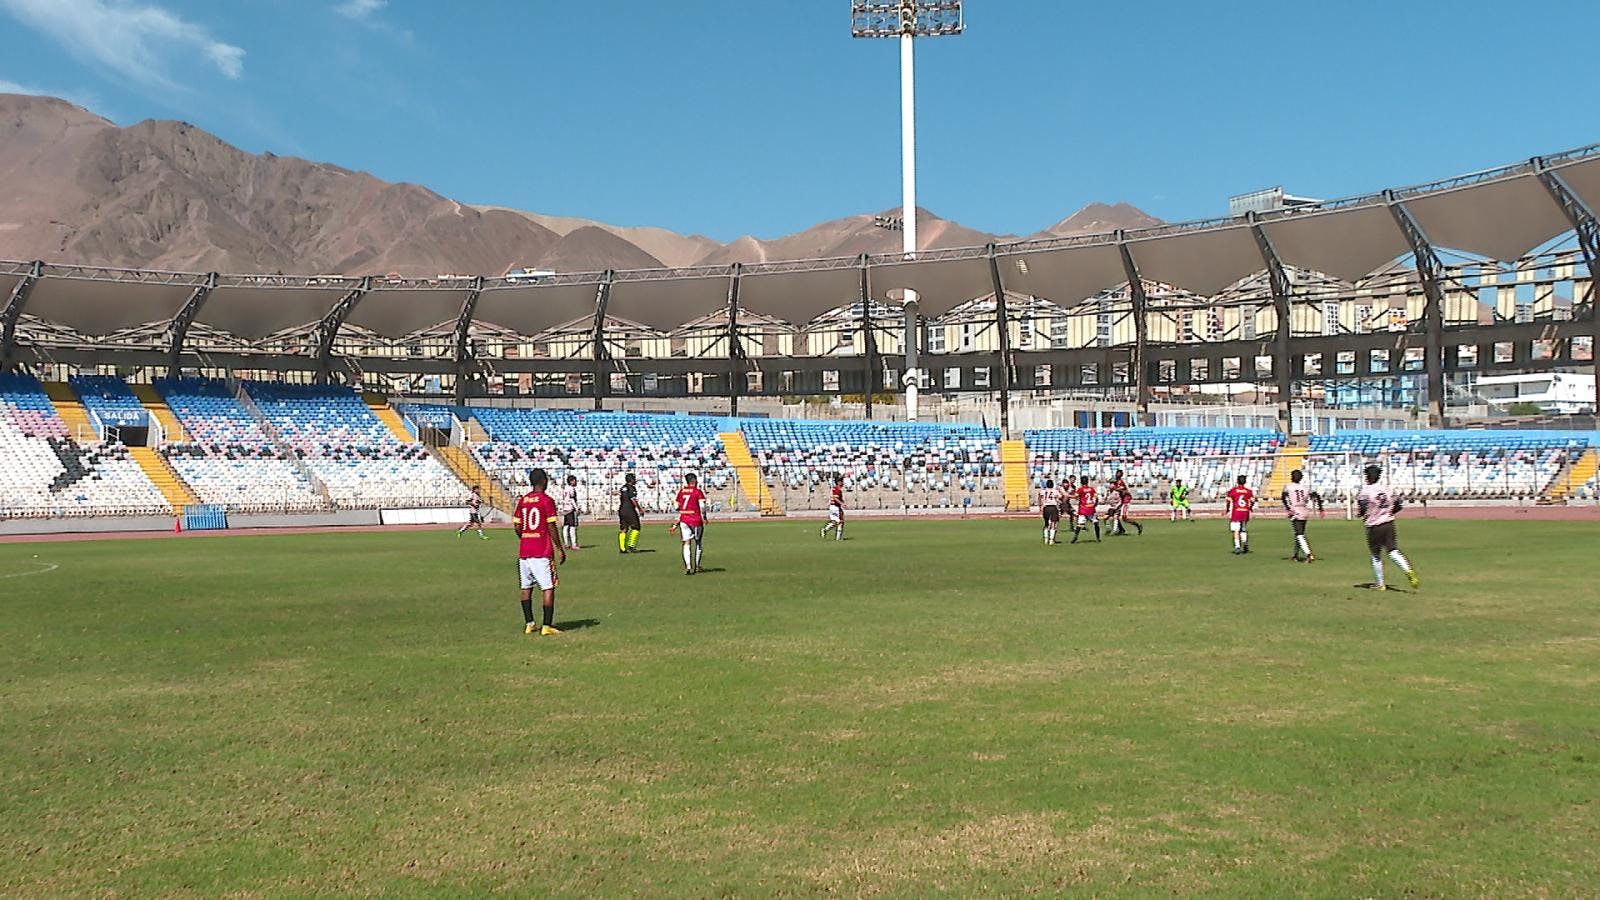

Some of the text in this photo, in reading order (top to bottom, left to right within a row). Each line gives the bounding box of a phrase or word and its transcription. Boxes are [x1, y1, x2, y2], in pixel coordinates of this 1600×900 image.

[104, 411, 140, 420] SALIDA
[682, 494, 691, 509] 7
[1238, 495, 1246, 507] 6
[521, 507, 540, 530] 10
